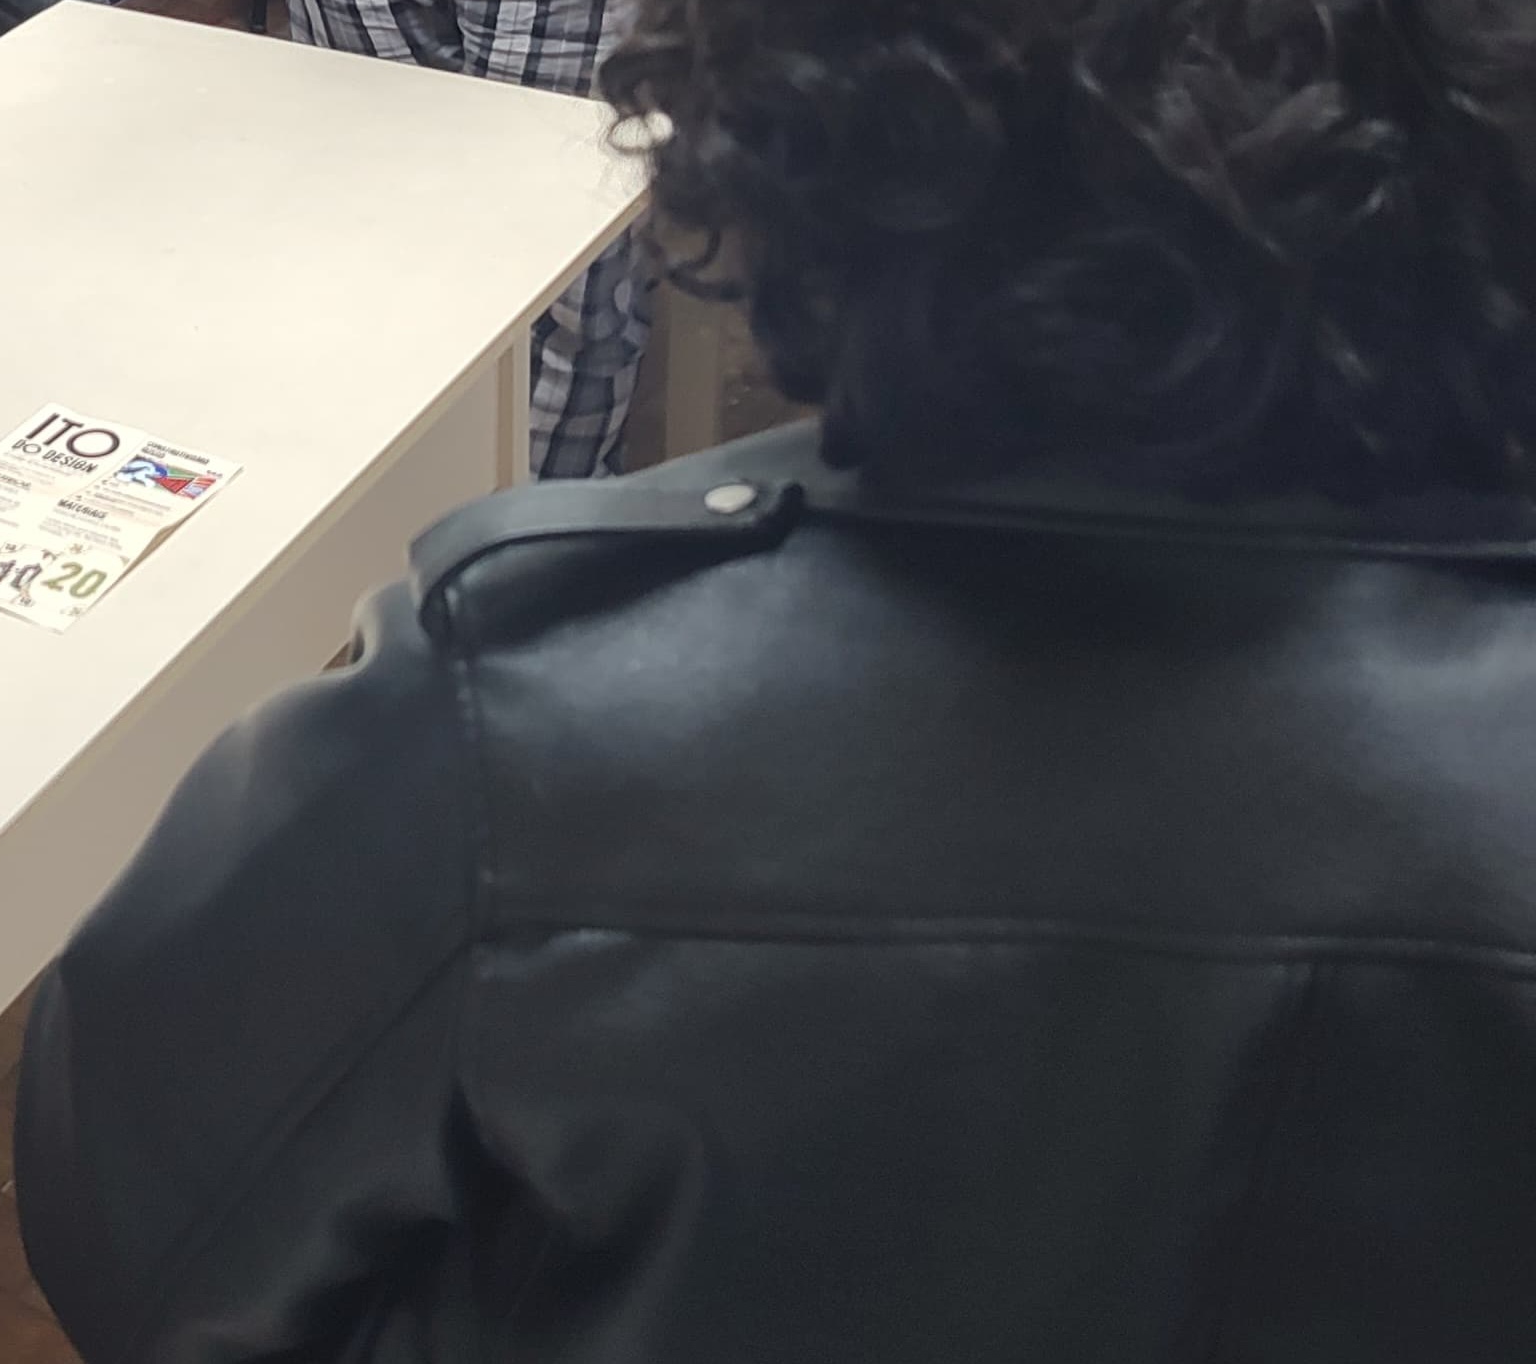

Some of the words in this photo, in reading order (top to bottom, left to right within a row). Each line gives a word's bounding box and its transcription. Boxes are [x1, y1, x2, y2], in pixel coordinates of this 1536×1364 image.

[24, 412, 120, 458] ITO
[11, 438, 42, 454] DO
[41, 449, 98, 474] DESIGN
[40, 561, 108, 599] 20
